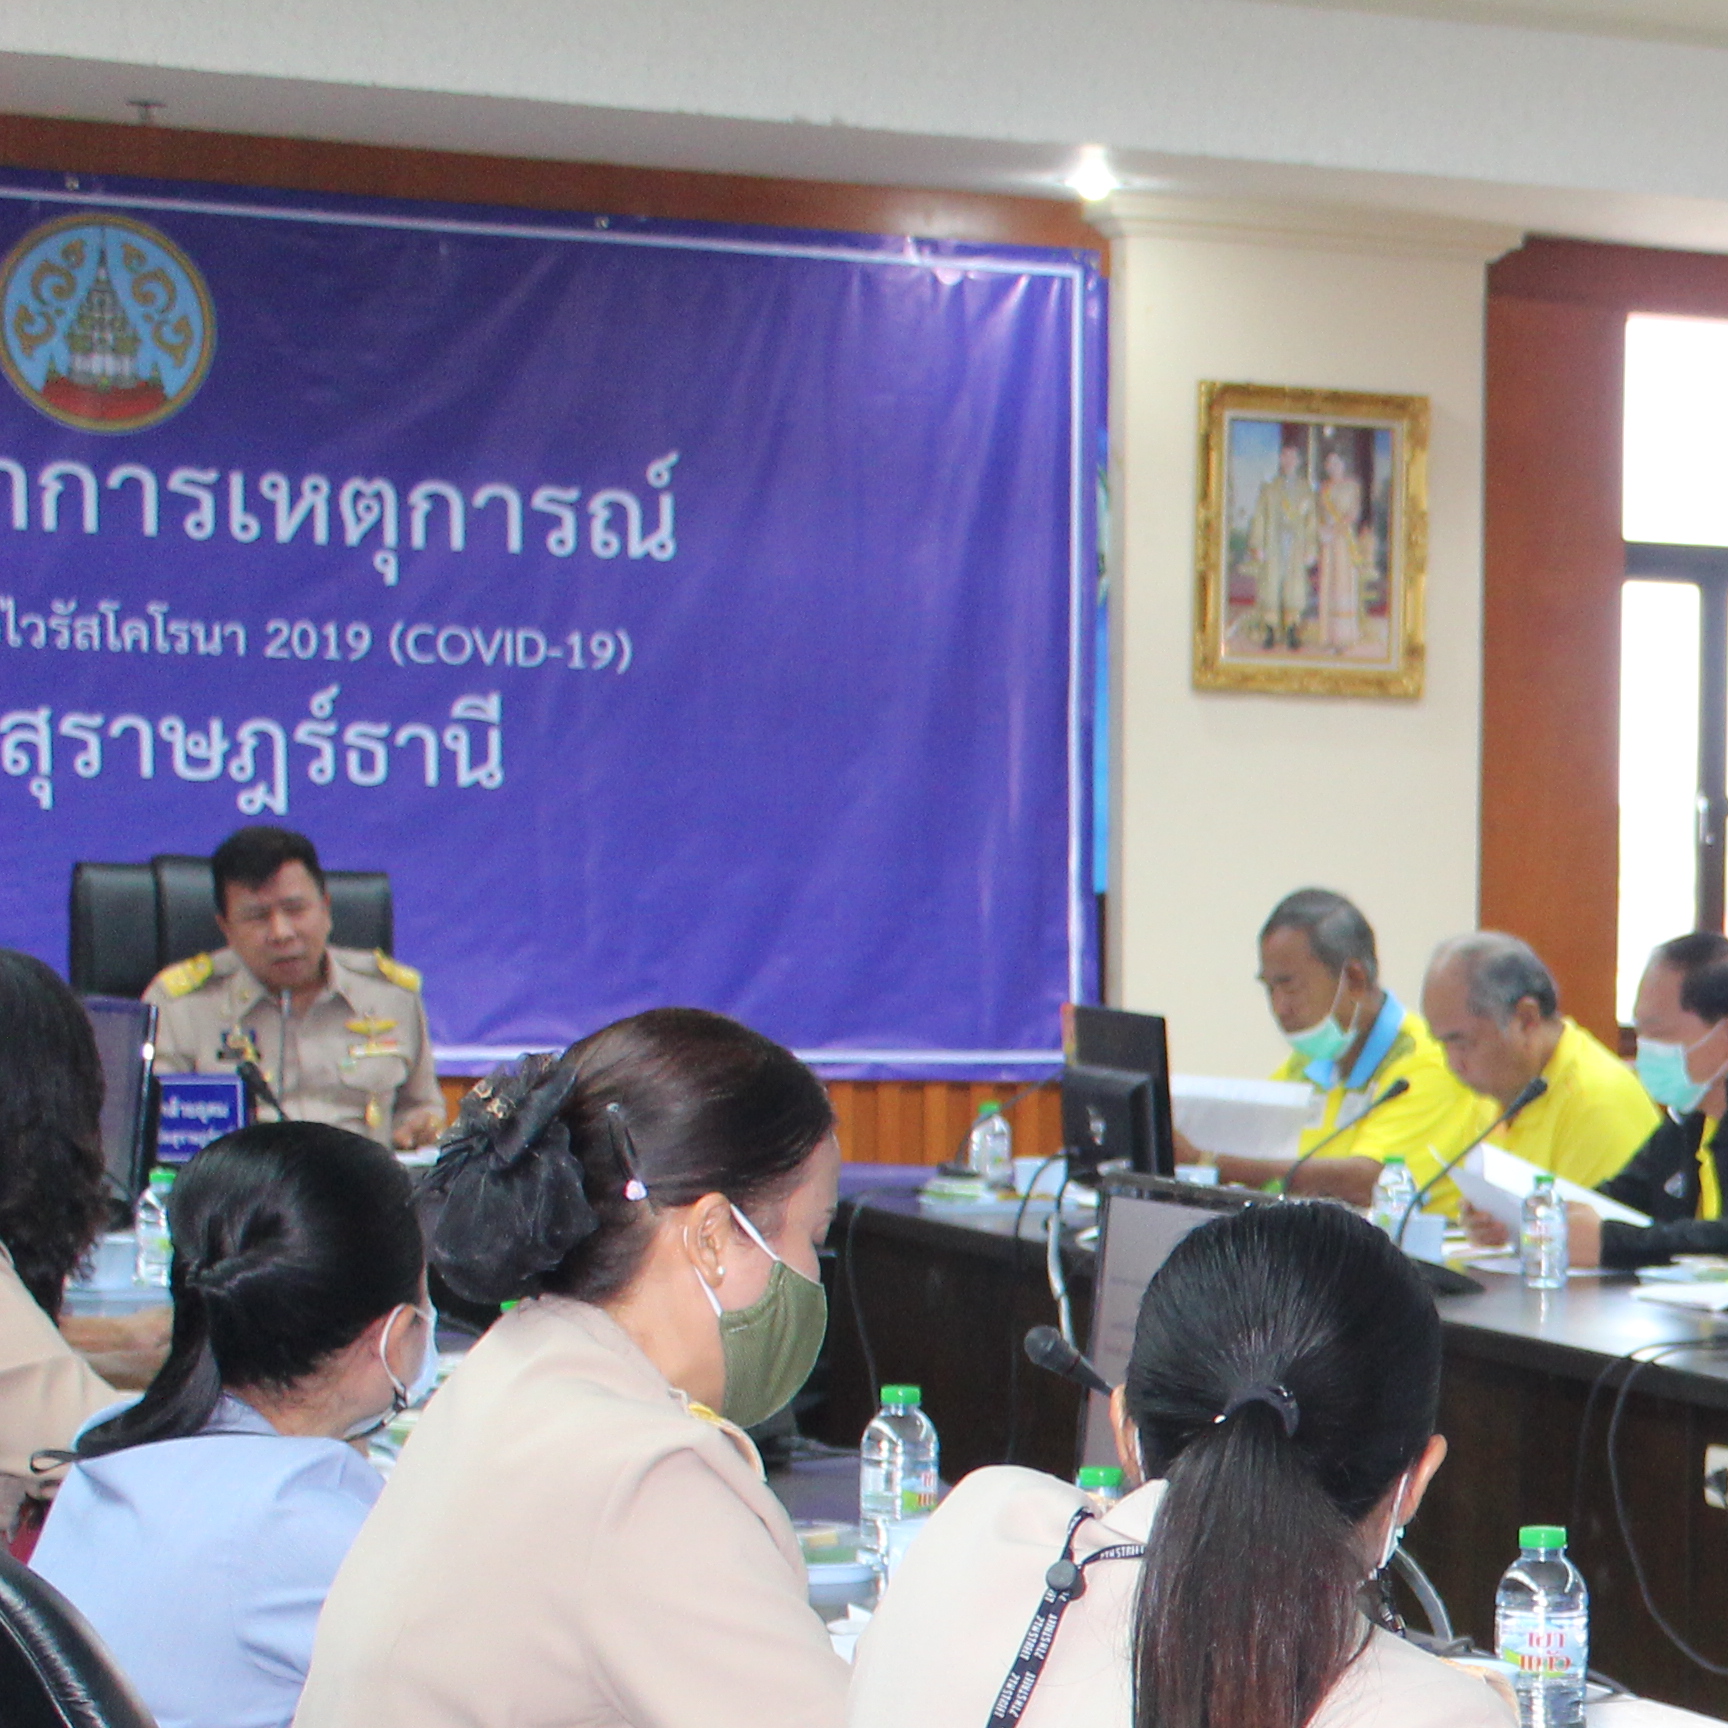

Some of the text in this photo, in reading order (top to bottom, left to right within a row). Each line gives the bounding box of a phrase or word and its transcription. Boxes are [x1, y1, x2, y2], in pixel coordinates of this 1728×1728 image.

[264, 618, 373, 661] 2019
[389, 620, 633, 675] (COVID-19)
[0, 683, 504, 816] สุราษฎร์ธานี
